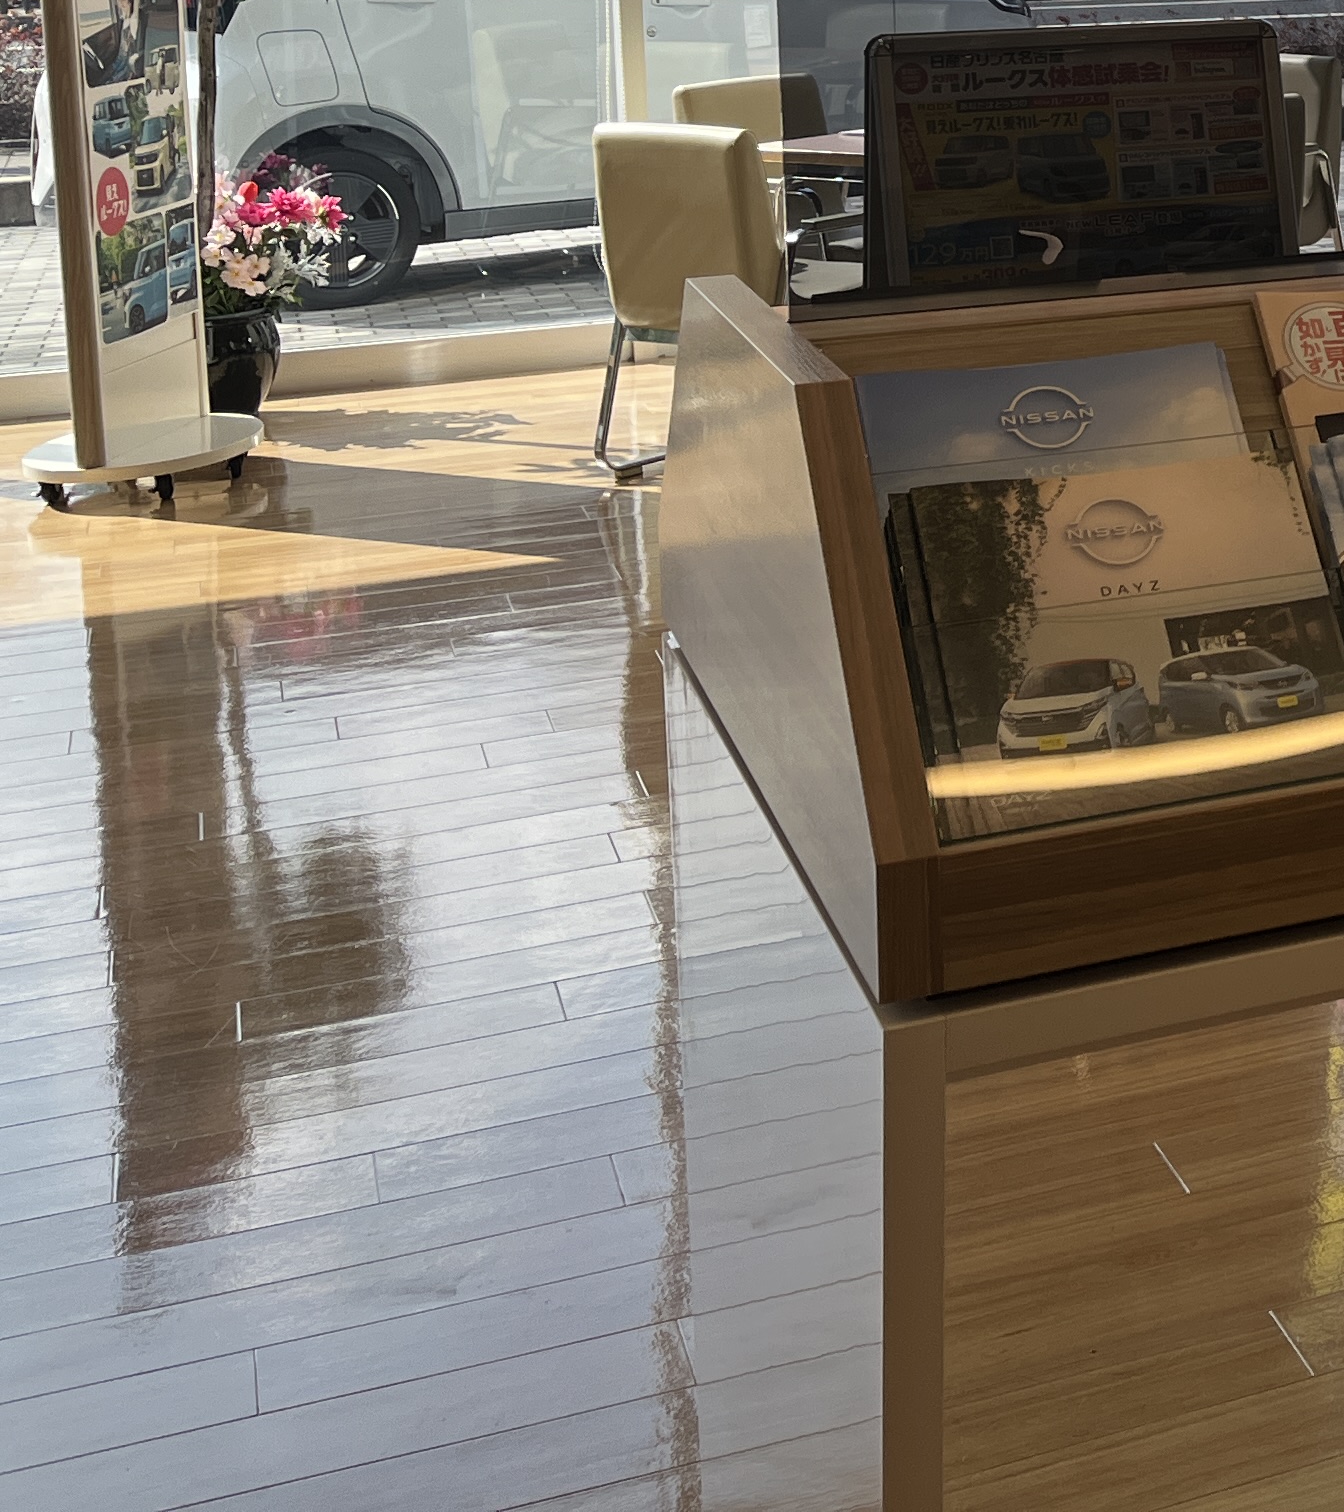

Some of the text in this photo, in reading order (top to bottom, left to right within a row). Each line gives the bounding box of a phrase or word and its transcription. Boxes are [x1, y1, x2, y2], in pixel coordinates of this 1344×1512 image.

[930, 51, 1064, 69] 日産プリンス名古屋
[961, 61, 1169, 92] ルークス体感試乗会!
[1001, 406, 1095, 427] NISSAN
[1024, 461, 1096, 477] KICKS
[1067, 520, 1163, 540] NISSAN
[1100, 580, 1161, 598] DAYZ
